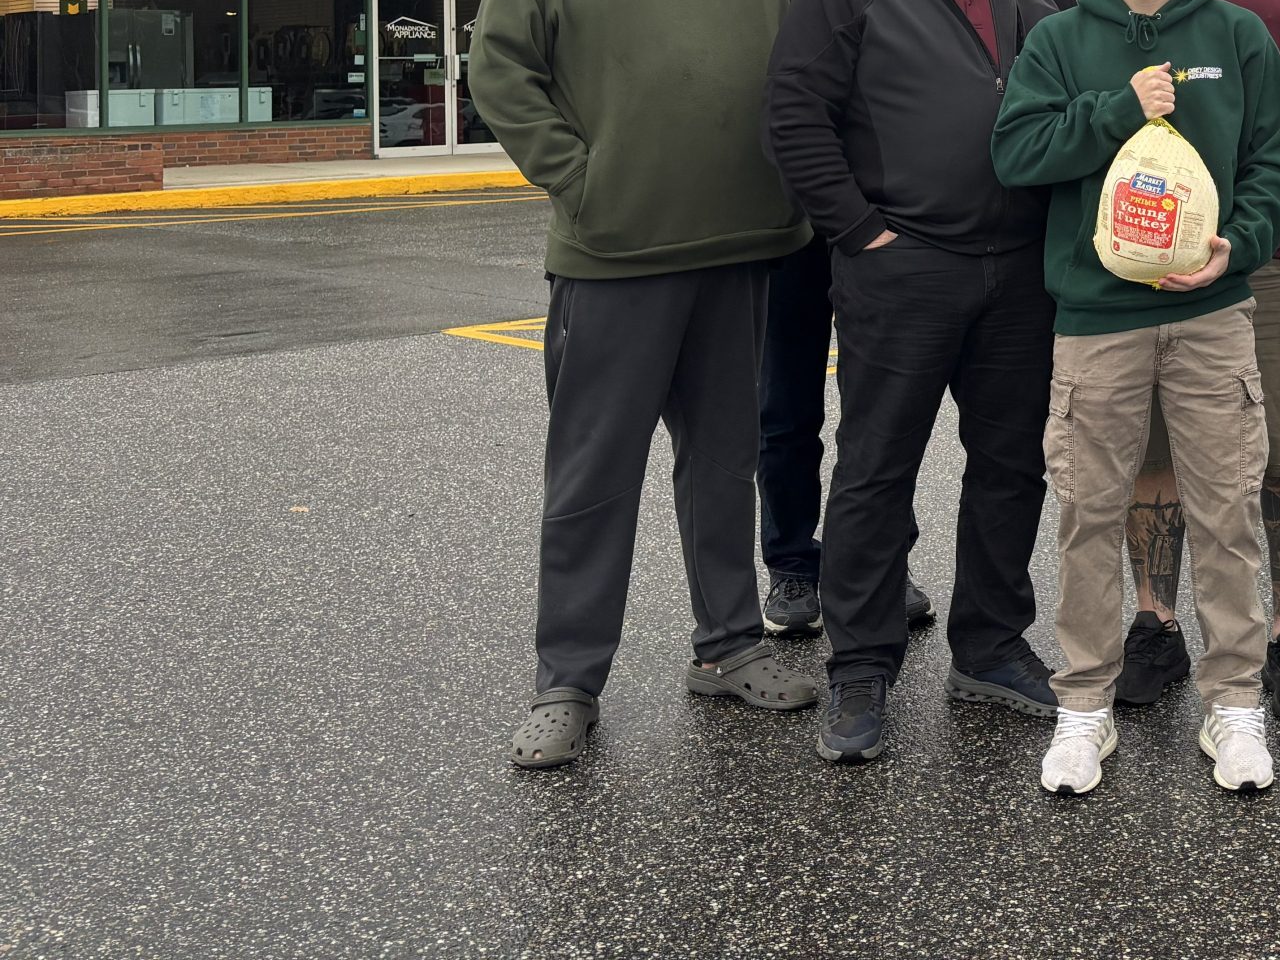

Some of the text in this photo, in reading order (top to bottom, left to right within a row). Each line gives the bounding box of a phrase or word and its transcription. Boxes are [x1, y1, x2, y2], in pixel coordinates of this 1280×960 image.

[1136, 174, 1163, 186] MARKET
[1135, 181, 1161, 194] BASKET
[1130, 196, 1157, 208] PRIME
[1119, 200, 1168, 221] Young
[1116, 211, 1170, 232] Turkey
